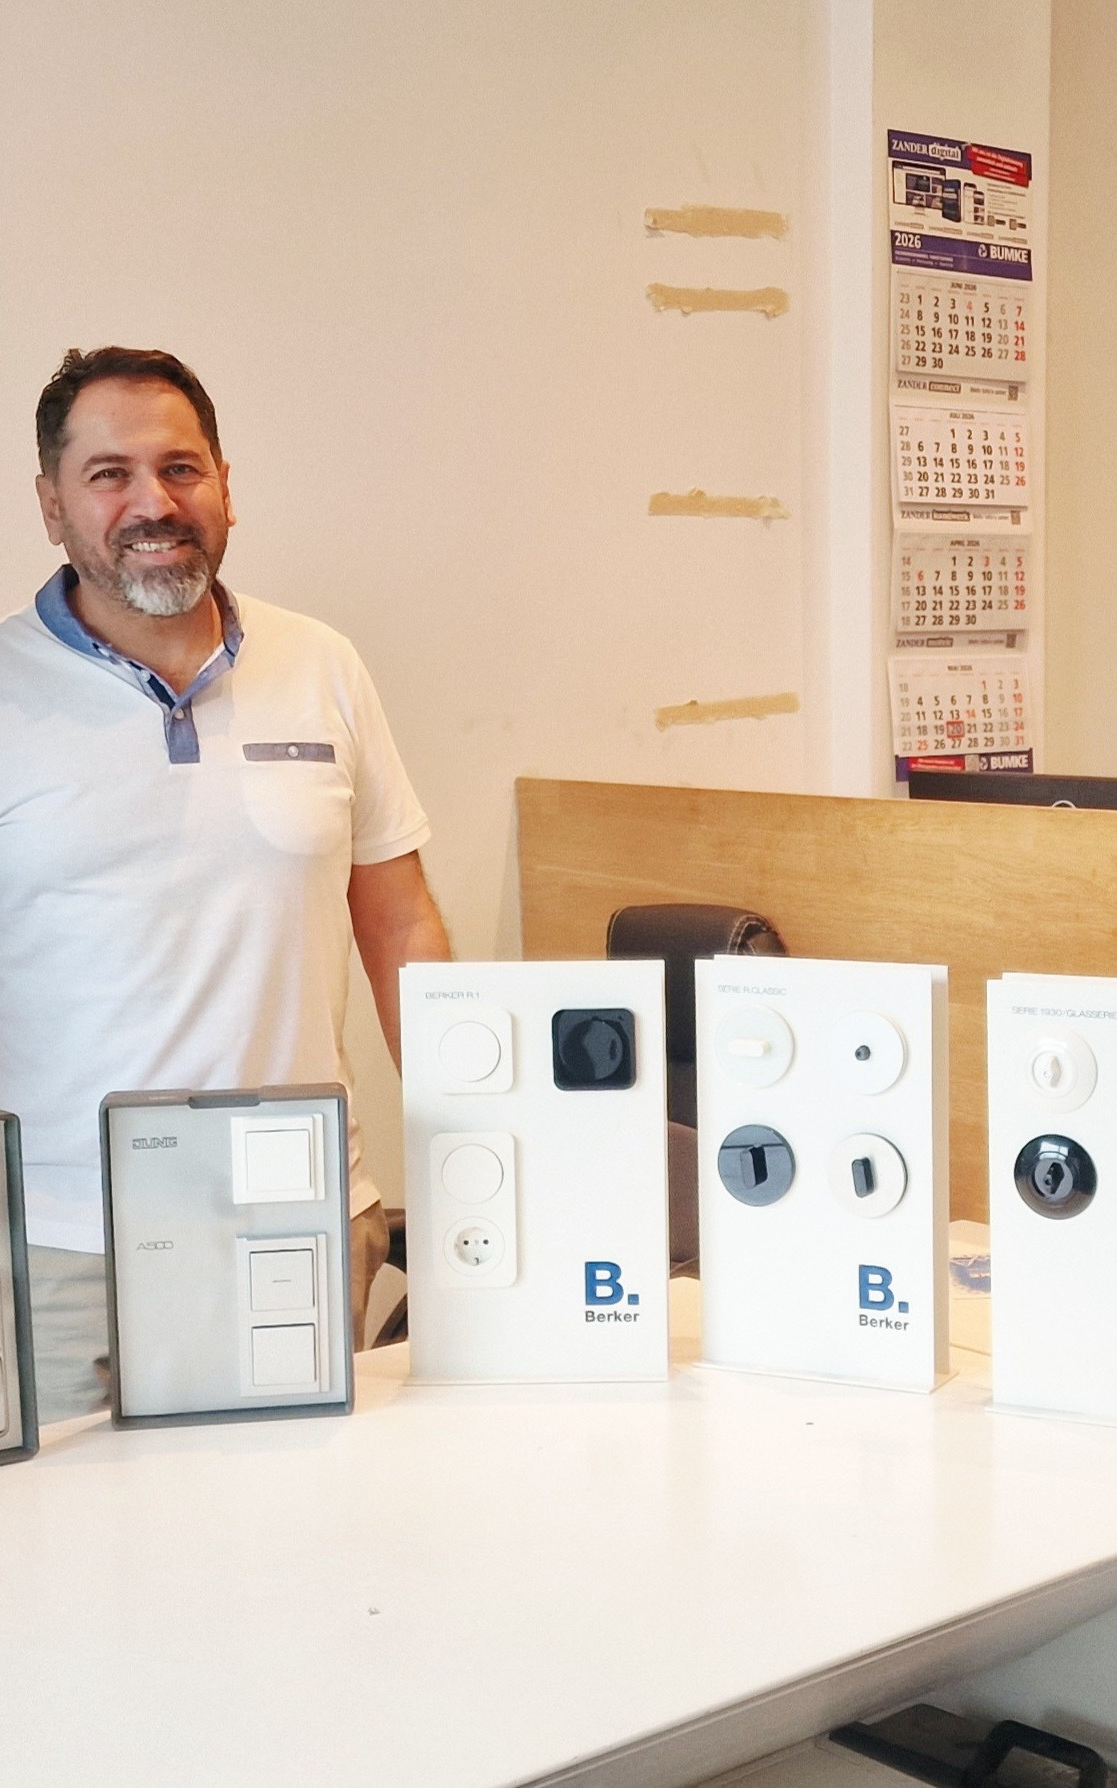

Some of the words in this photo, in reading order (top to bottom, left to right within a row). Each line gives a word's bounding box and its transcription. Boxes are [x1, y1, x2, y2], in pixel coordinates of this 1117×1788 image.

[892, 139, 928, 155] ZANDER
[932, 142, 960, 160] digital
[894, 233, 922, 249] 2026
[990, 245, 1029, 263] BUMKE
[948, 314, 959, 325] 10
[964, 316, 975, 326] 11
[981, 317, 992, 328] 12
[998, 319, 1008, 330] 13
[1014, 321, 1025, 331] 14
[915, 325, 925, 337] 15
[932, 327, 942, 338] 16
[948, 329, 959, 340] 17
[965, 331, 975, 342] 18
[981, 332, 992, 343] 19
[998, 334, 1009, 345] 20
[1014, 335, 1024, 346] 21
[915, 340, 926, 352] 22
[932, 342, 942, 353] 23
[948, 344, 959, 355] 24
[965, 345, 976, 357] 25
[981, 347, 993, 358] 26
[998, 348, 1009, 359] 27
[1014, 350, 1026, 361] 28
[916, 355, 927, 367] 29
[932, 357, 943, 369] 30
[897, 379, 928, 390] ZANDER
[982, 445, 992, 455] 10
[998, 446, 1008, 456] 11
[1014, 447, 1024, 457] 12
[917, 456, 927, 467] 13
[933, 457, 944, 467] 14
[950, 458, 960, 469] 15
[966, 459, 977, 469] 16
[983, 460, 993, 470] 17
[999, 460, 1010, 471] 18
[1015, 461, 1025, 472] 19
[917, 471, 929, 482] 20
[934, 472, 944, 483] 21
[951, 473, 961, 483] 22
[967, 473, 978, 484] 23
[984, 474, 995, 485] 24
[1000, 475, 1010, 486] 25
[1015, 476, 1026, 486] 26
[918, 486, 929, 497] 27
[935, 487, 947, 498] 28
[952, 487, 963, 498] 29
[969, 488, 980, 499] 30
[985, 489, 995, 499] 31
[901, 510, 931, 520] ZANDER
[982, 571, 992, 581] 10
[1014, 571, 1025, 581] 12
[916, 585, 926, 596] 13
[933, 585, 943, 596] 14
[949, 585, 960, 596] 15
[966, 585, 976, 596] 16
[982, 585, 992, 595] 17
[1014, 585, 1025, 596] 19
[915, 600, 927, 611] 20
[932, 600, 943, 611] 21
[949, 600, 960, 611] 22
[965, 600, 976, 611] 23
[982, 600, 993, 610] 24
[998, 599, 1009, 610] 25
[1014, 599, 1025, 610] 26
[915, 615, 926, 626] 27
[932, 615, 943, 625] 28
[949, 615, 960, 625] 29
[965, 614, 977, 625] 30
[896, 638, 925, 648] ZANDER
[916, 711, 926, 721] 11
[933, 710, 943, 720] 12
[950, 709, 960, 721] 13
[982, 708, 992, 718] 15
[917, 725, 928, 736] 18
[934, 724, 945, 735] 19
[967, 723, 977, 734] 21
[983, 722, 993, 733] 22
[934, 739, 946, 750] 26
[951, 738, 962, 749] 27
[967, 737, 979, 748] 28
[984, 737, 995, 747] 29
[991, 755, 1029, 770] BUMKE
[425, 991, 465, 1000] BERKER
[1011, 1006, 1038, 1016] SERIE
[132, 1136, 178, 1150] JUNG
[585, 1310, 640, 1323] Berker
[858, 1314, 910, 1332] Berker
